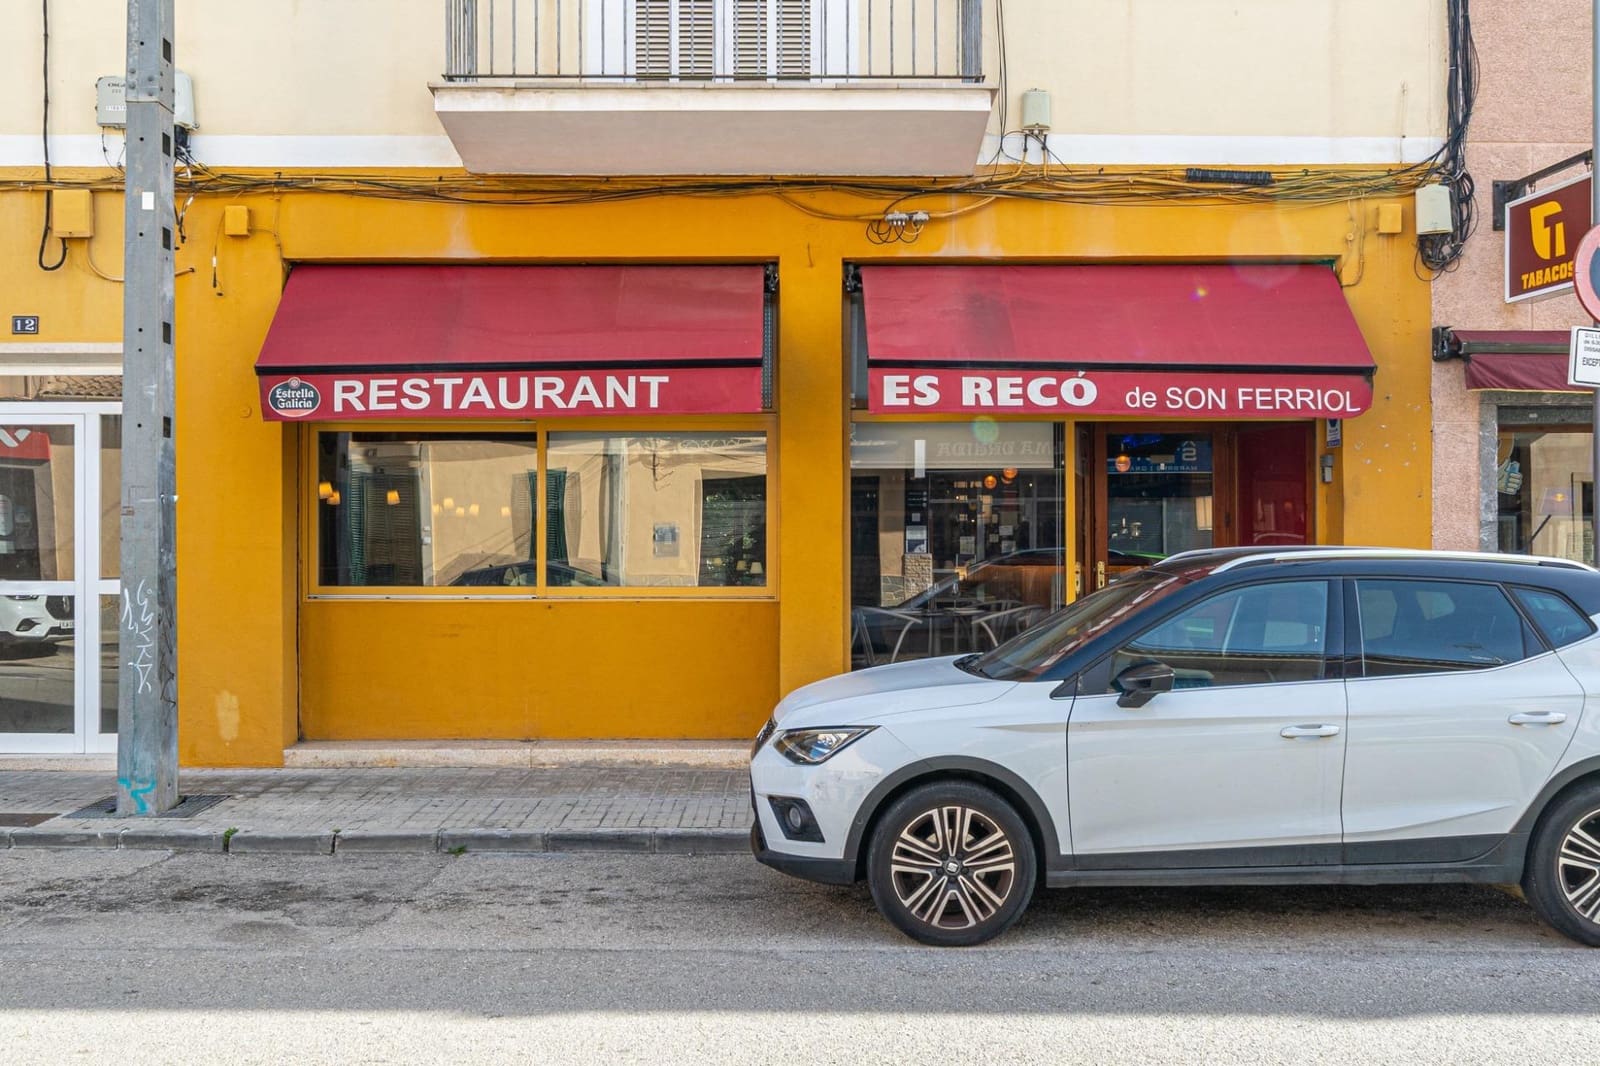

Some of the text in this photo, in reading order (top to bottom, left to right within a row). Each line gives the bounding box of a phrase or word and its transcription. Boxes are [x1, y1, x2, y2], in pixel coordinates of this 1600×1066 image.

[1521, 260, 1574, 290] TABACOS
[15, 318, 35, 331] 12
[275, 387, 315, 399] Estrella
[333, 375, 670, 412] RESTAURANT
[883, 370, 1361, 412] ES RECÓ de SON FERRIOL
[276, 398, 313, 409] Galicia
